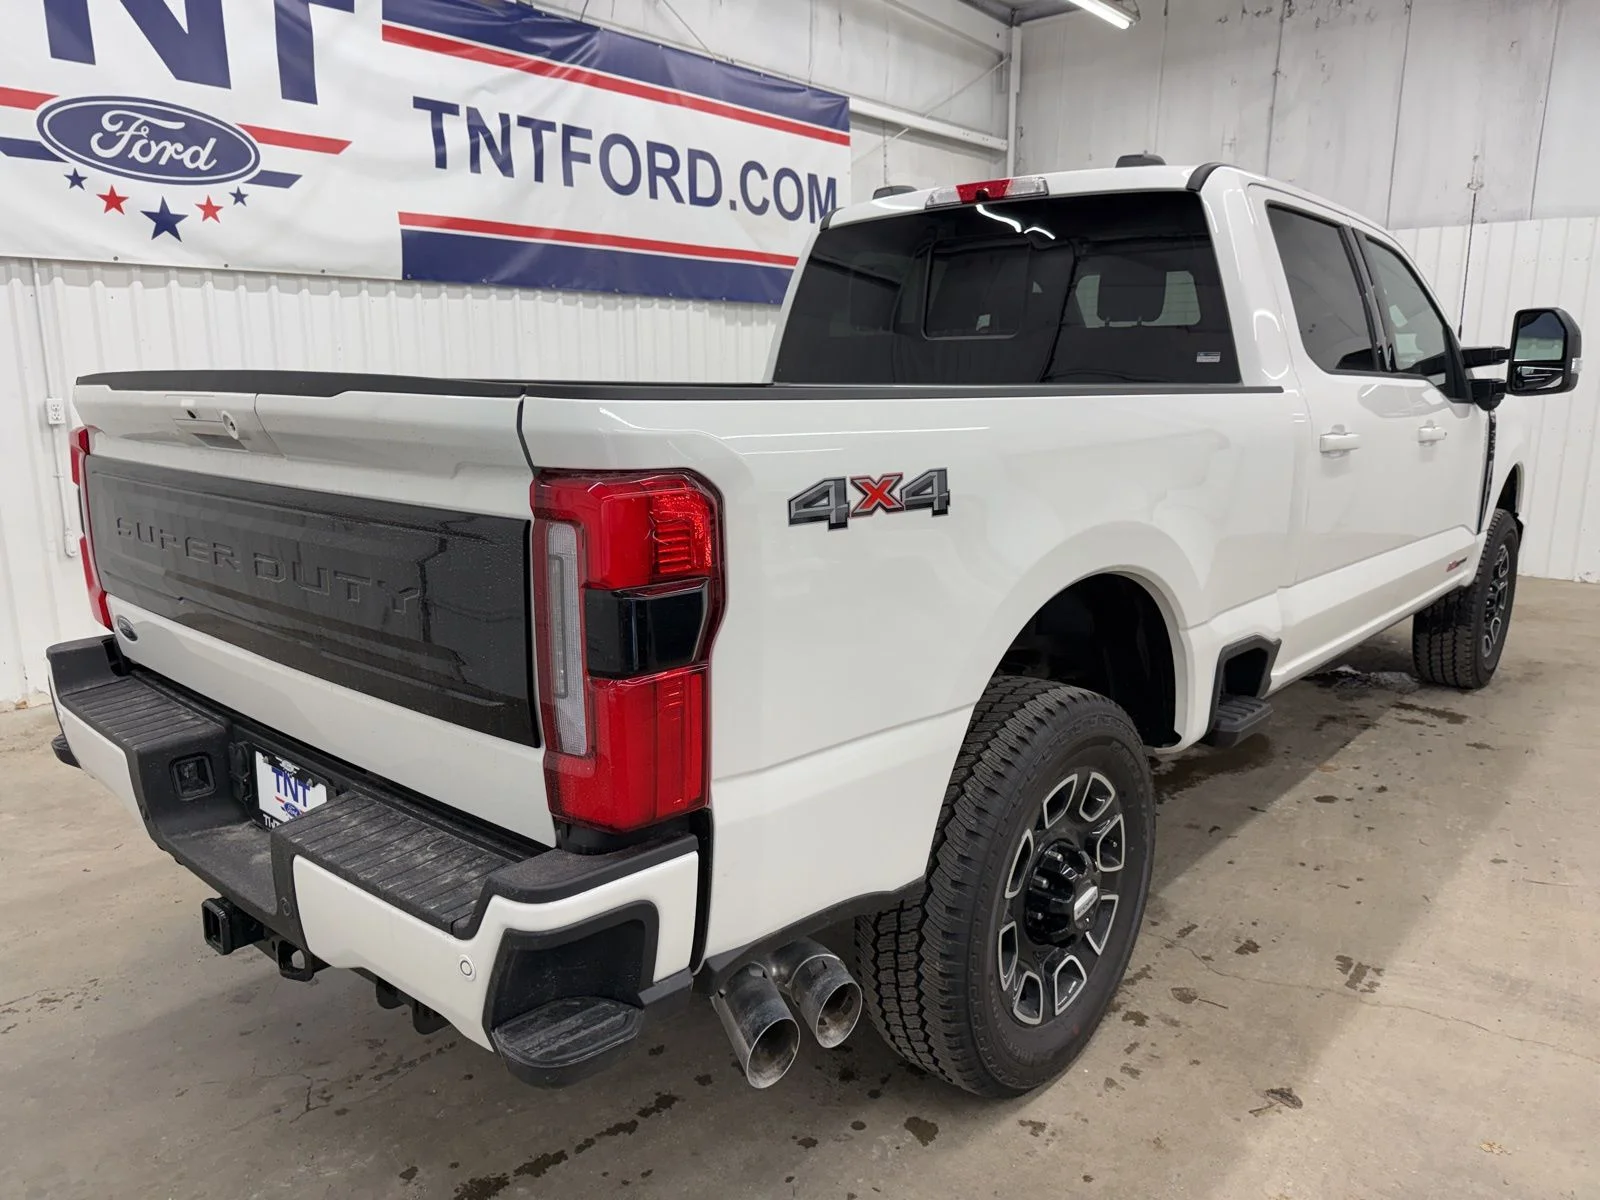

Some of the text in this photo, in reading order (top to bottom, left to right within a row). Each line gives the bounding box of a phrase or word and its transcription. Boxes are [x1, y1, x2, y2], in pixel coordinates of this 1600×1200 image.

[90, 110, 217, 172] Ford
[412, 96, 837, 225] TNTFORD.COM
[116, 517, 421, 614] SUPER DUTY
[271, 767, 310, 808] TNT
